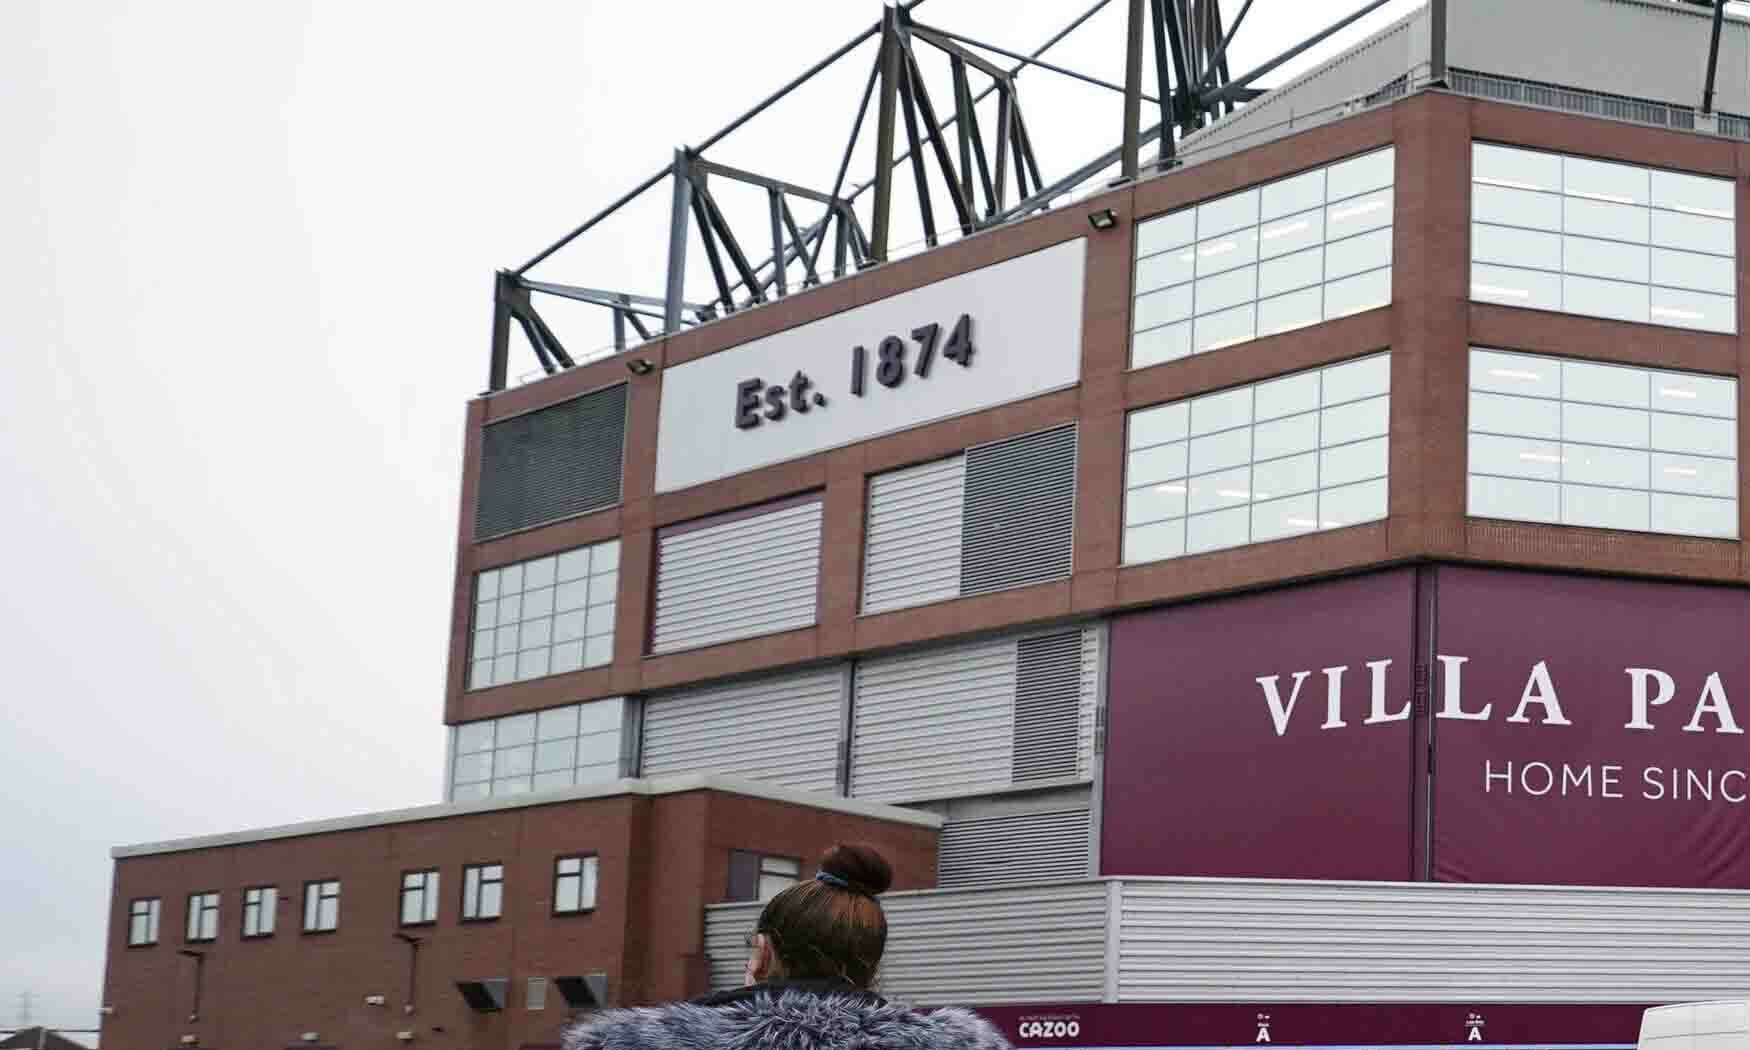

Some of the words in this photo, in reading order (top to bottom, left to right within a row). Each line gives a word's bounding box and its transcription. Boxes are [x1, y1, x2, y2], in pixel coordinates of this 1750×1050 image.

[735, 370, 827, 430] Est.
[850, 313, 977, 398] 1874
[1256, 655, 1572, 736] VILLA
[1484, 759, 1623, 800] HOME
[1018, 1021, 1081, 1038] CAZOO
[1256, 1027, 1271, 1042] A
[1468, 1026, 1482, 1041] A
